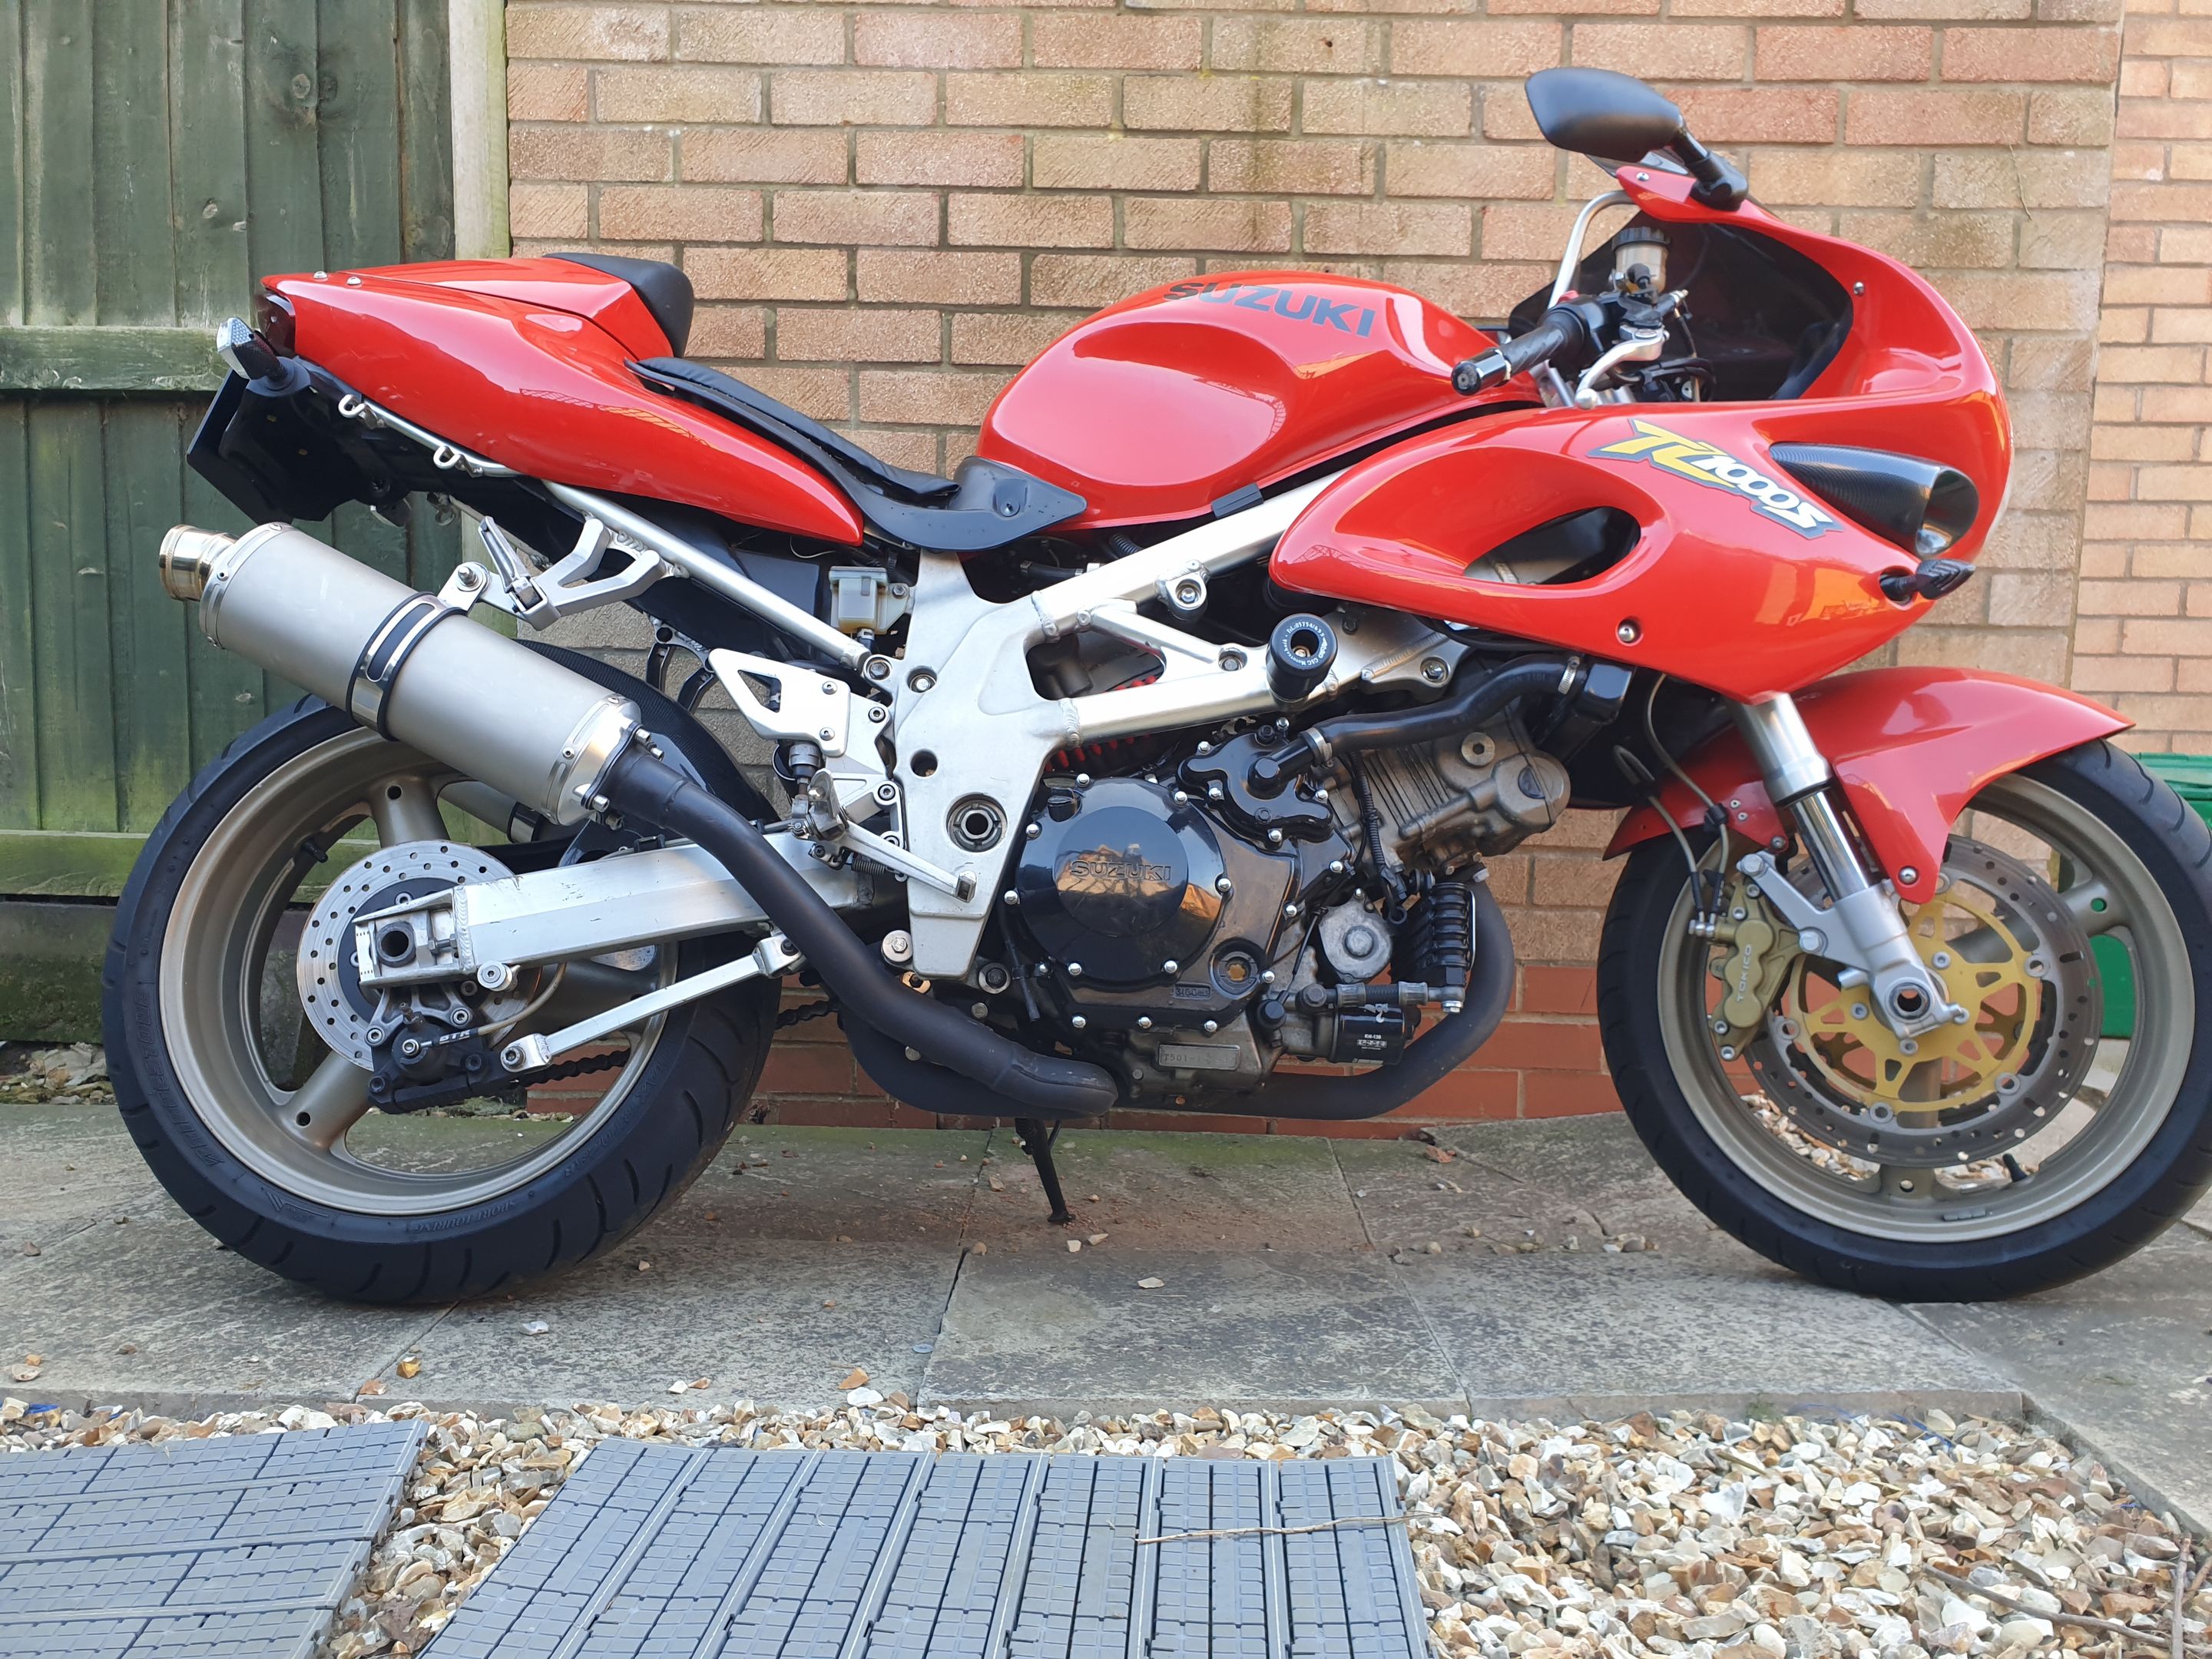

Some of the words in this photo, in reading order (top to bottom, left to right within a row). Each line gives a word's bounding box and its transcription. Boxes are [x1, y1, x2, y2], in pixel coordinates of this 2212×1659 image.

[1163, 282, 1376, 338] SUZUKI
[1588, 418, 1840, 538] TL1000S
[1071, 859, 1172, 882] SUZUKI
[1737, 944, 1752, 1003] TOKICO
